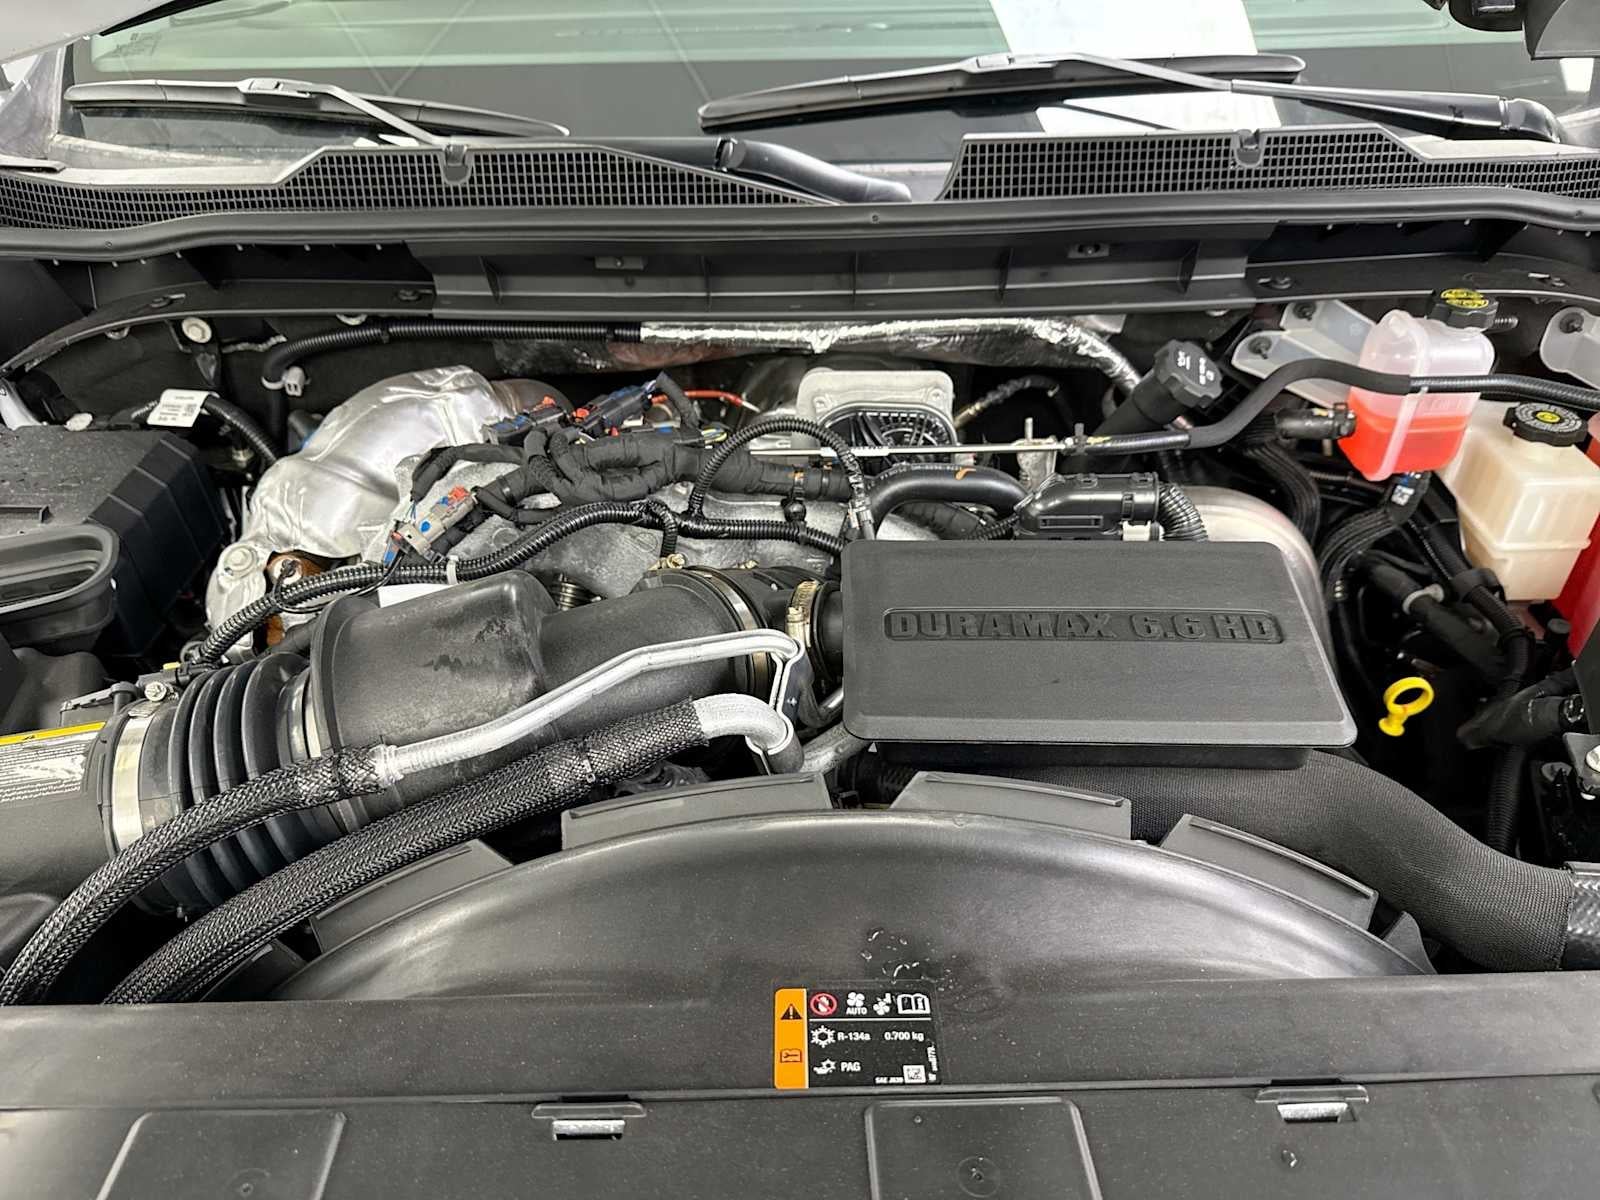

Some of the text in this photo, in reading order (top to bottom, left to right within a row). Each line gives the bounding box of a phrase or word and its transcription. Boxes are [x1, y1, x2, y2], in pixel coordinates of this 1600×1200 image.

[889, 612, 1281, 640] DURAMAX 6.6 HD
[846, 1007, 867, 1015] AUTO
[837, 1031, 925, 1042] R-134a 0.700 kg
[840, 1061, 861, 1072] PAG
